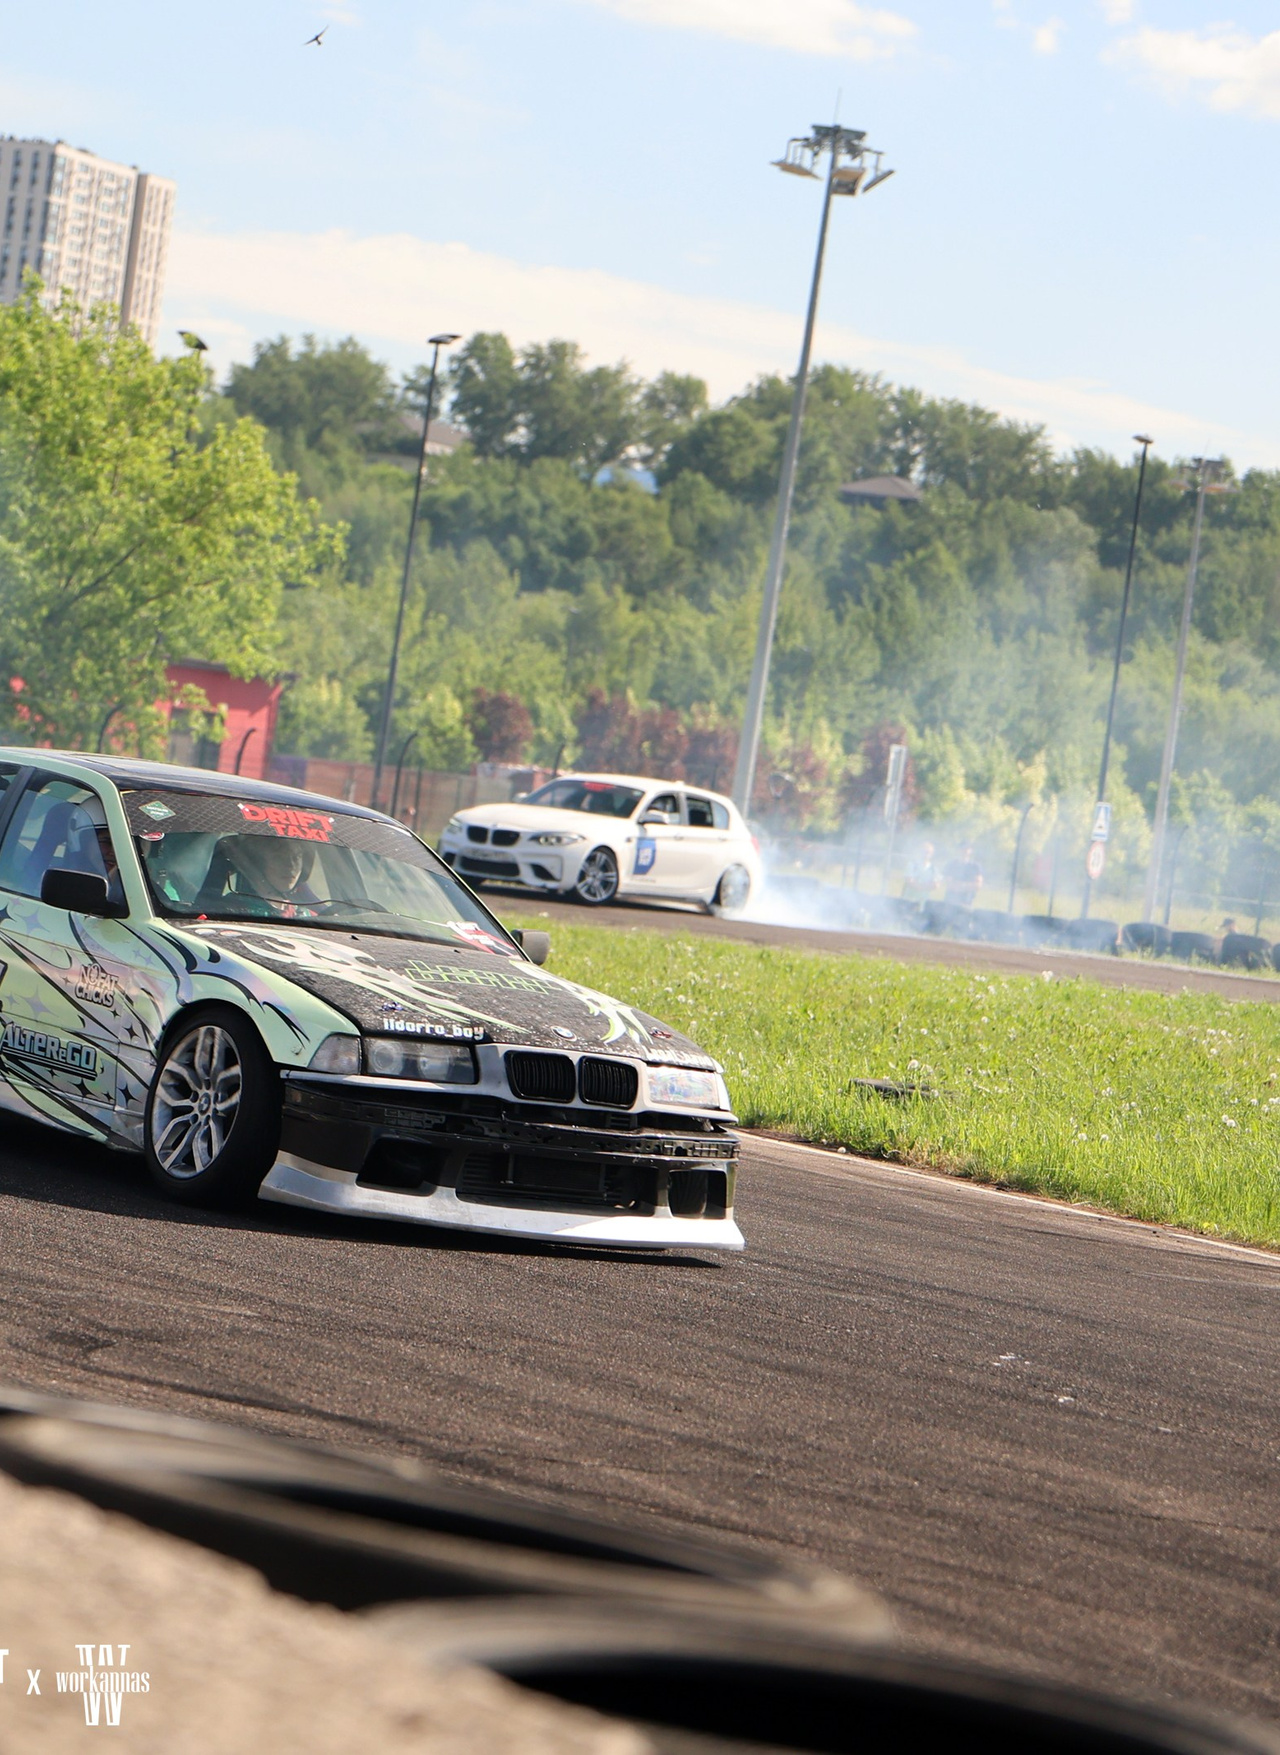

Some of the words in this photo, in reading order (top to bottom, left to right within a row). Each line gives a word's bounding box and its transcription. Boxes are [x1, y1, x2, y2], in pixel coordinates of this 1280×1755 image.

[242, 804, 333, 832] DRIFT
[271, 822, 320, 842] TAXI
[75, 981, 115, 1007] CHICKS
[96, 973, 119, 993] FAT
